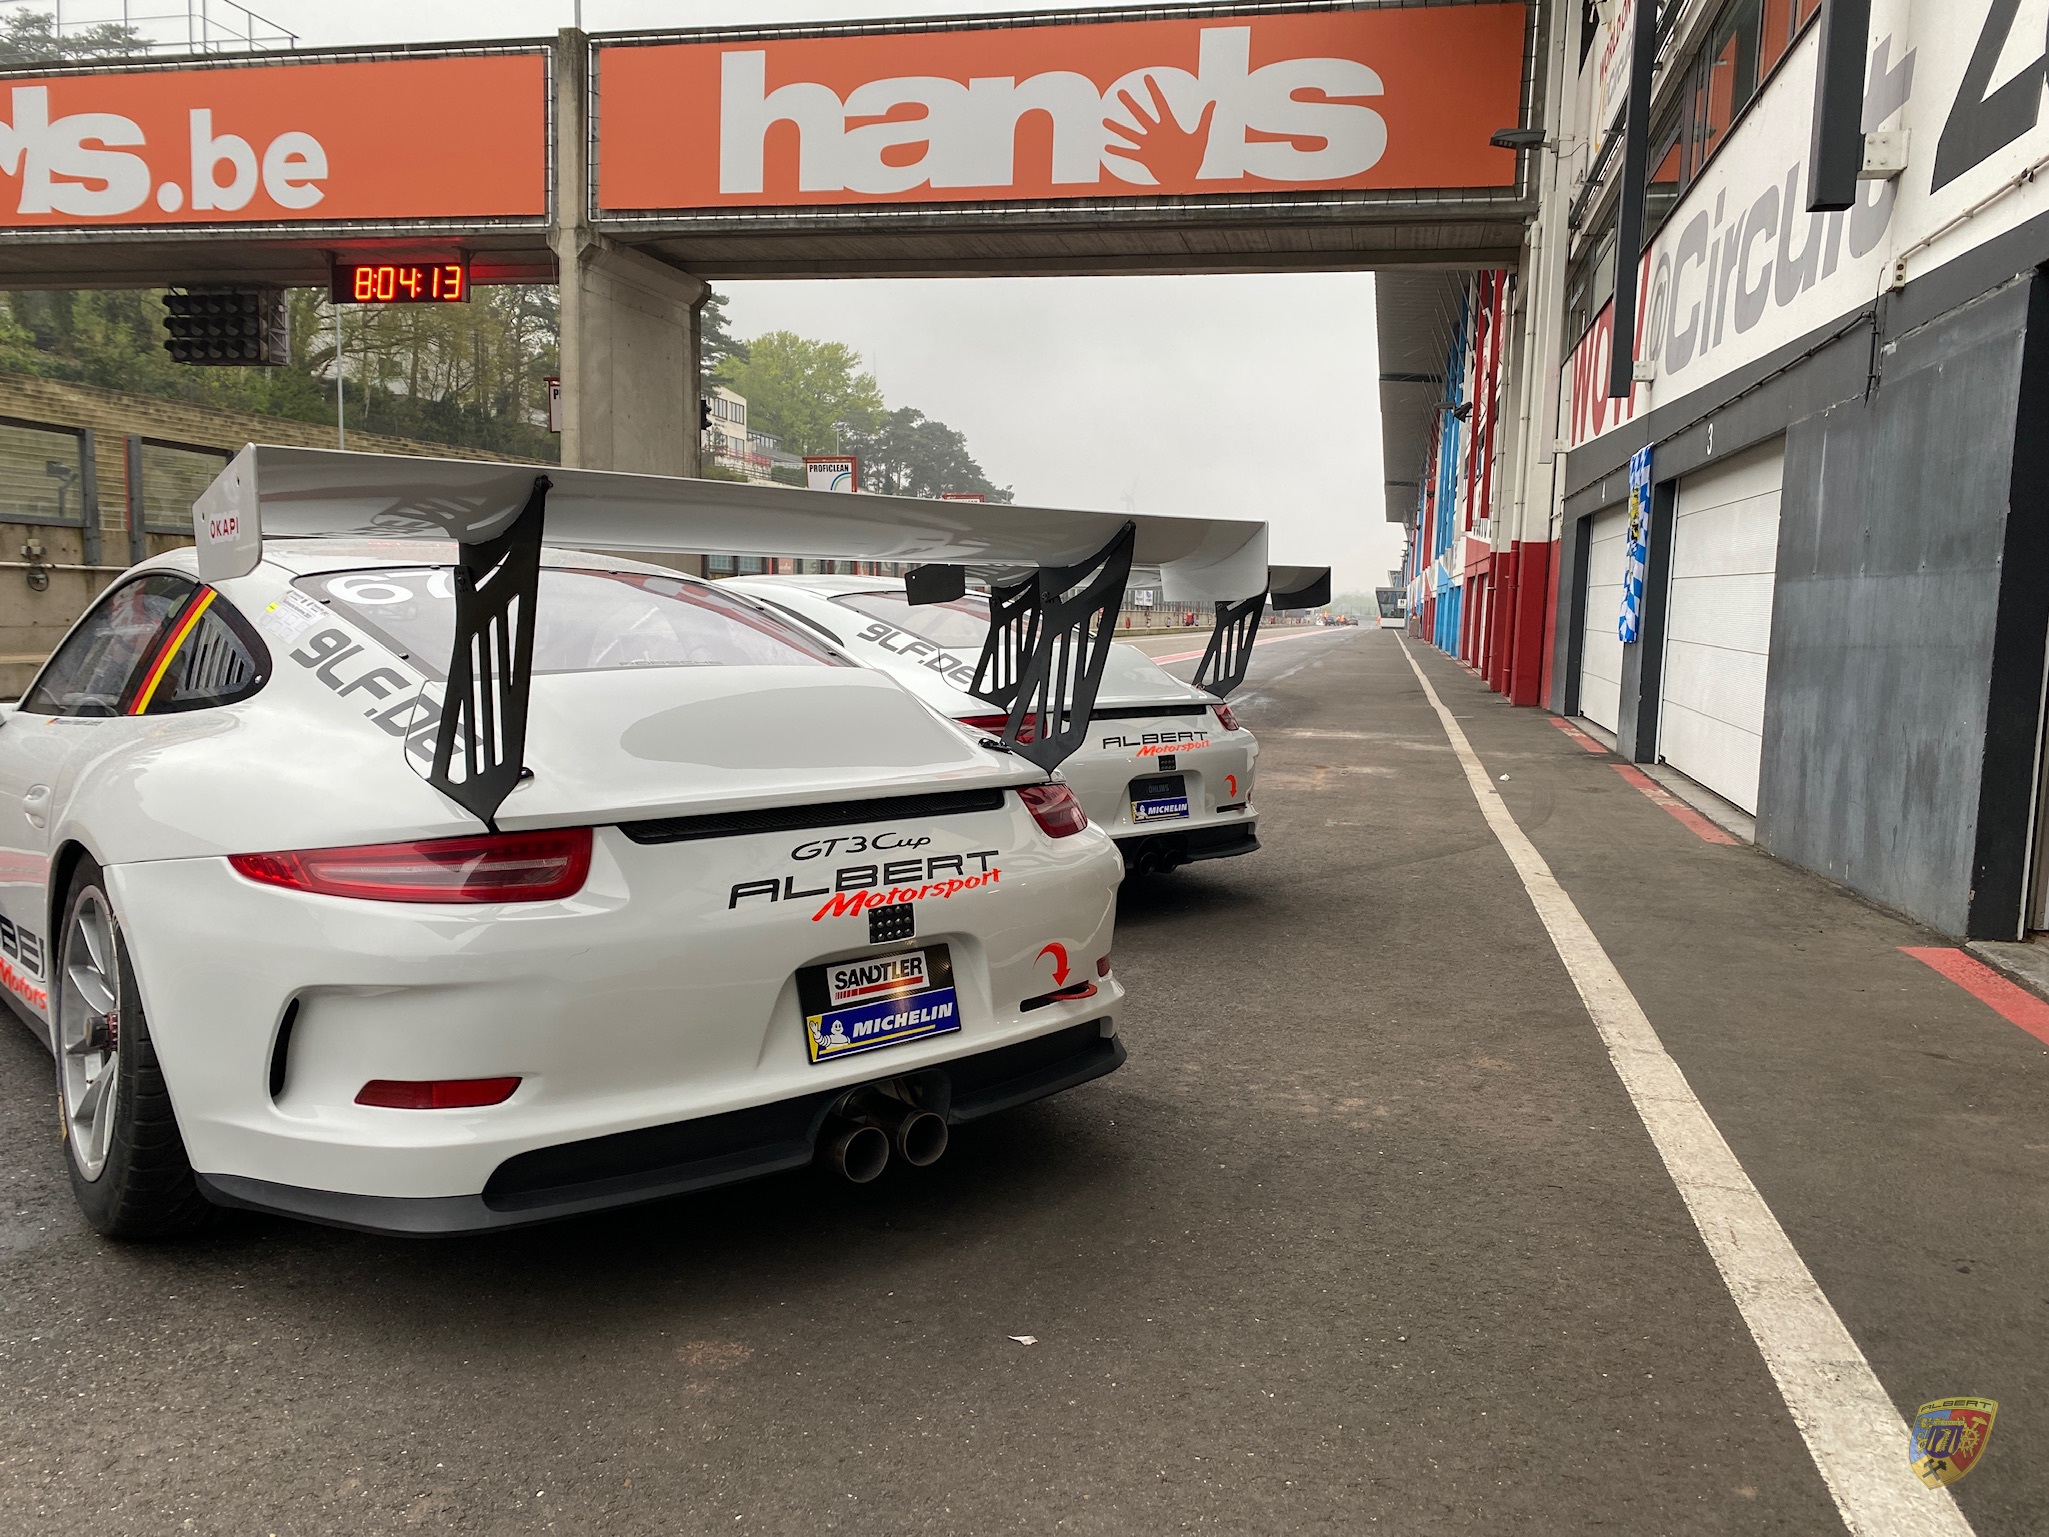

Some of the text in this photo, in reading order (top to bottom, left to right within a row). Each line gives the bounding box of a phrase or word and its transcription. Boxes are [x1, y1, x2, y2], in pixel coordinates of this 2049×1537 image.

[719, 26, 1388, 195] hands
[355, 266, 463, 301] 8:04:13
[1706, 423, 1715, 455] 3
[809, 464, 849, 473] PROFICLEAN
[210, 516, 239, 539] OKAPI
[857, 623, 986, 684] 9LF.DE
[1103, 732, 1207, 749] ALBERT
[1136, 739, 1210, 757] Motorsport
[1148, 803, 1187, 815] MICHELIN
[728, 850, 999, 909] ALBERT
[811, 868, 1002, 922] Motorsport
[834, 956, 923, 990] SANDTLER
[852, 1002, 954, 1038] MICHELIN
